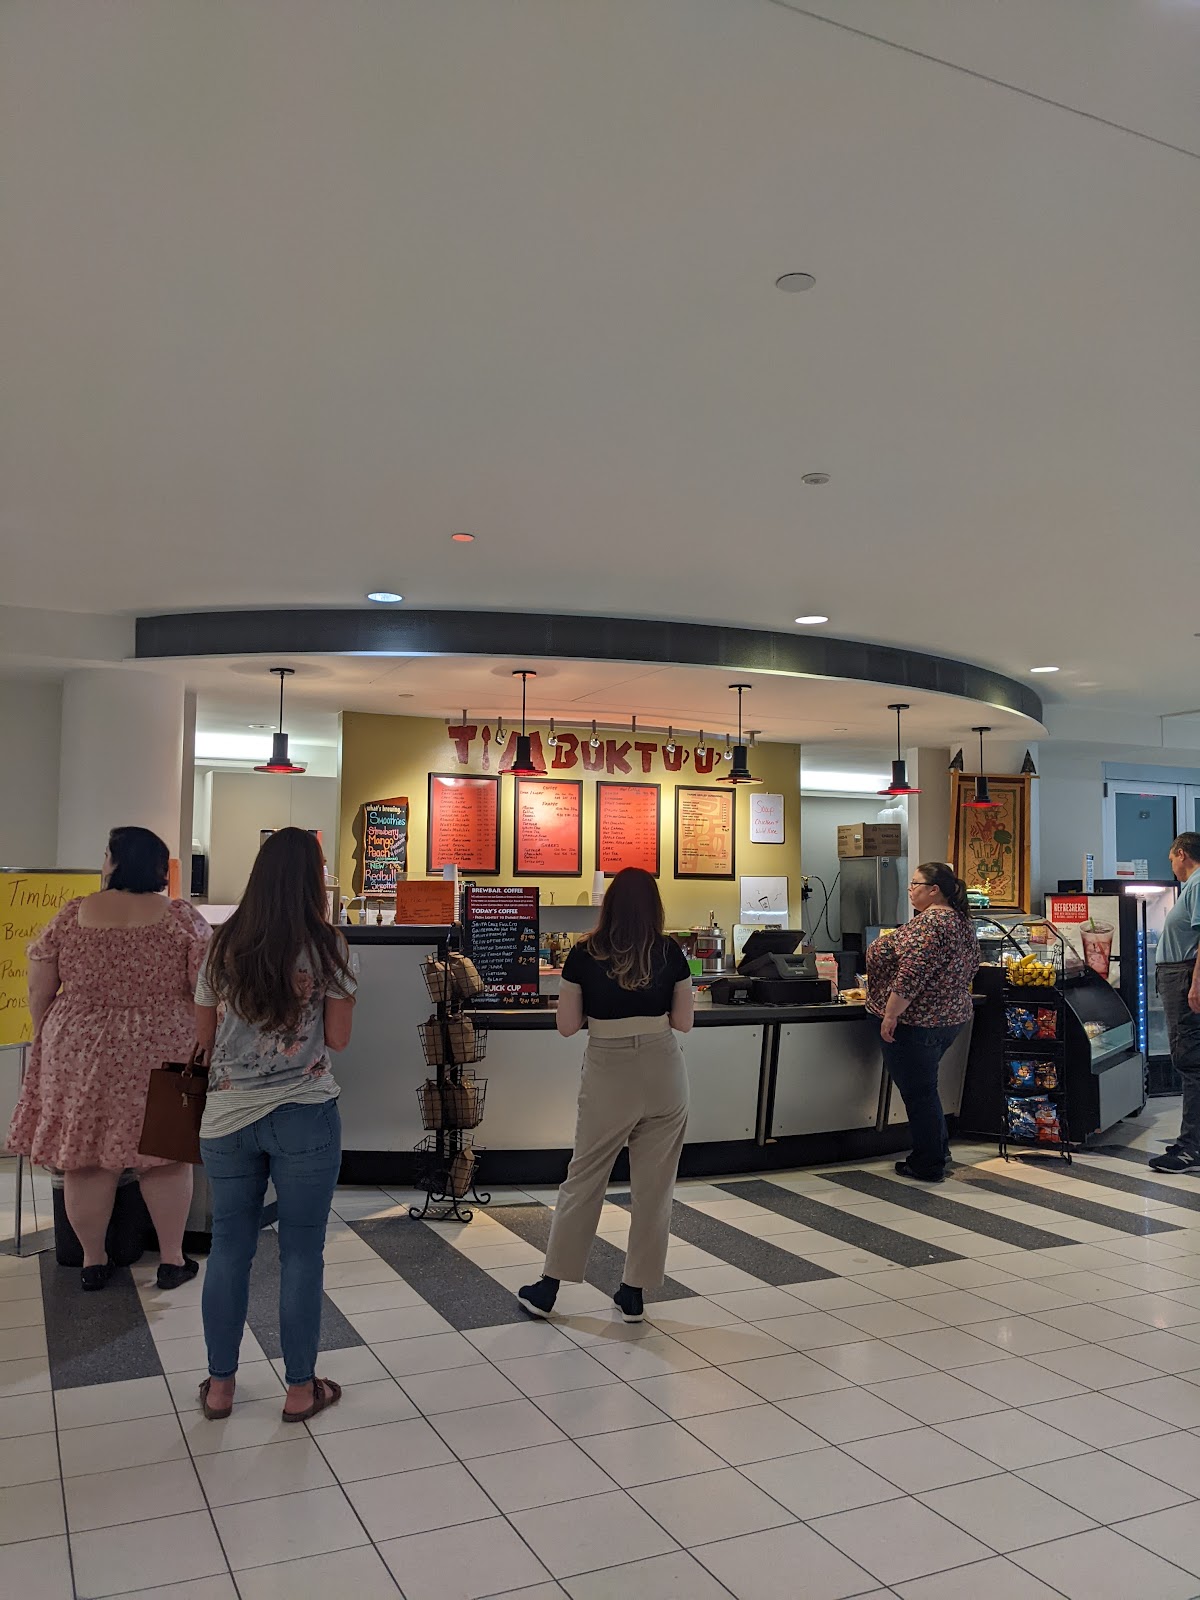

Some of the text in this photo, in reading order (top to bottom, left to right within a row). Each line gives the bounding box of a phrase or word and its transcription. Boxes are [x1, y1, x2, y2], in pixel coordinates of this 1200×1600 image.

[369, 811, 406, 826] Smoothies
[368, 834, 395, 850] Mango
[368, 845, 391, 858] Peach
[365, 868, 397, 882] Redbull
[506, 984, 522, 992] CUP
